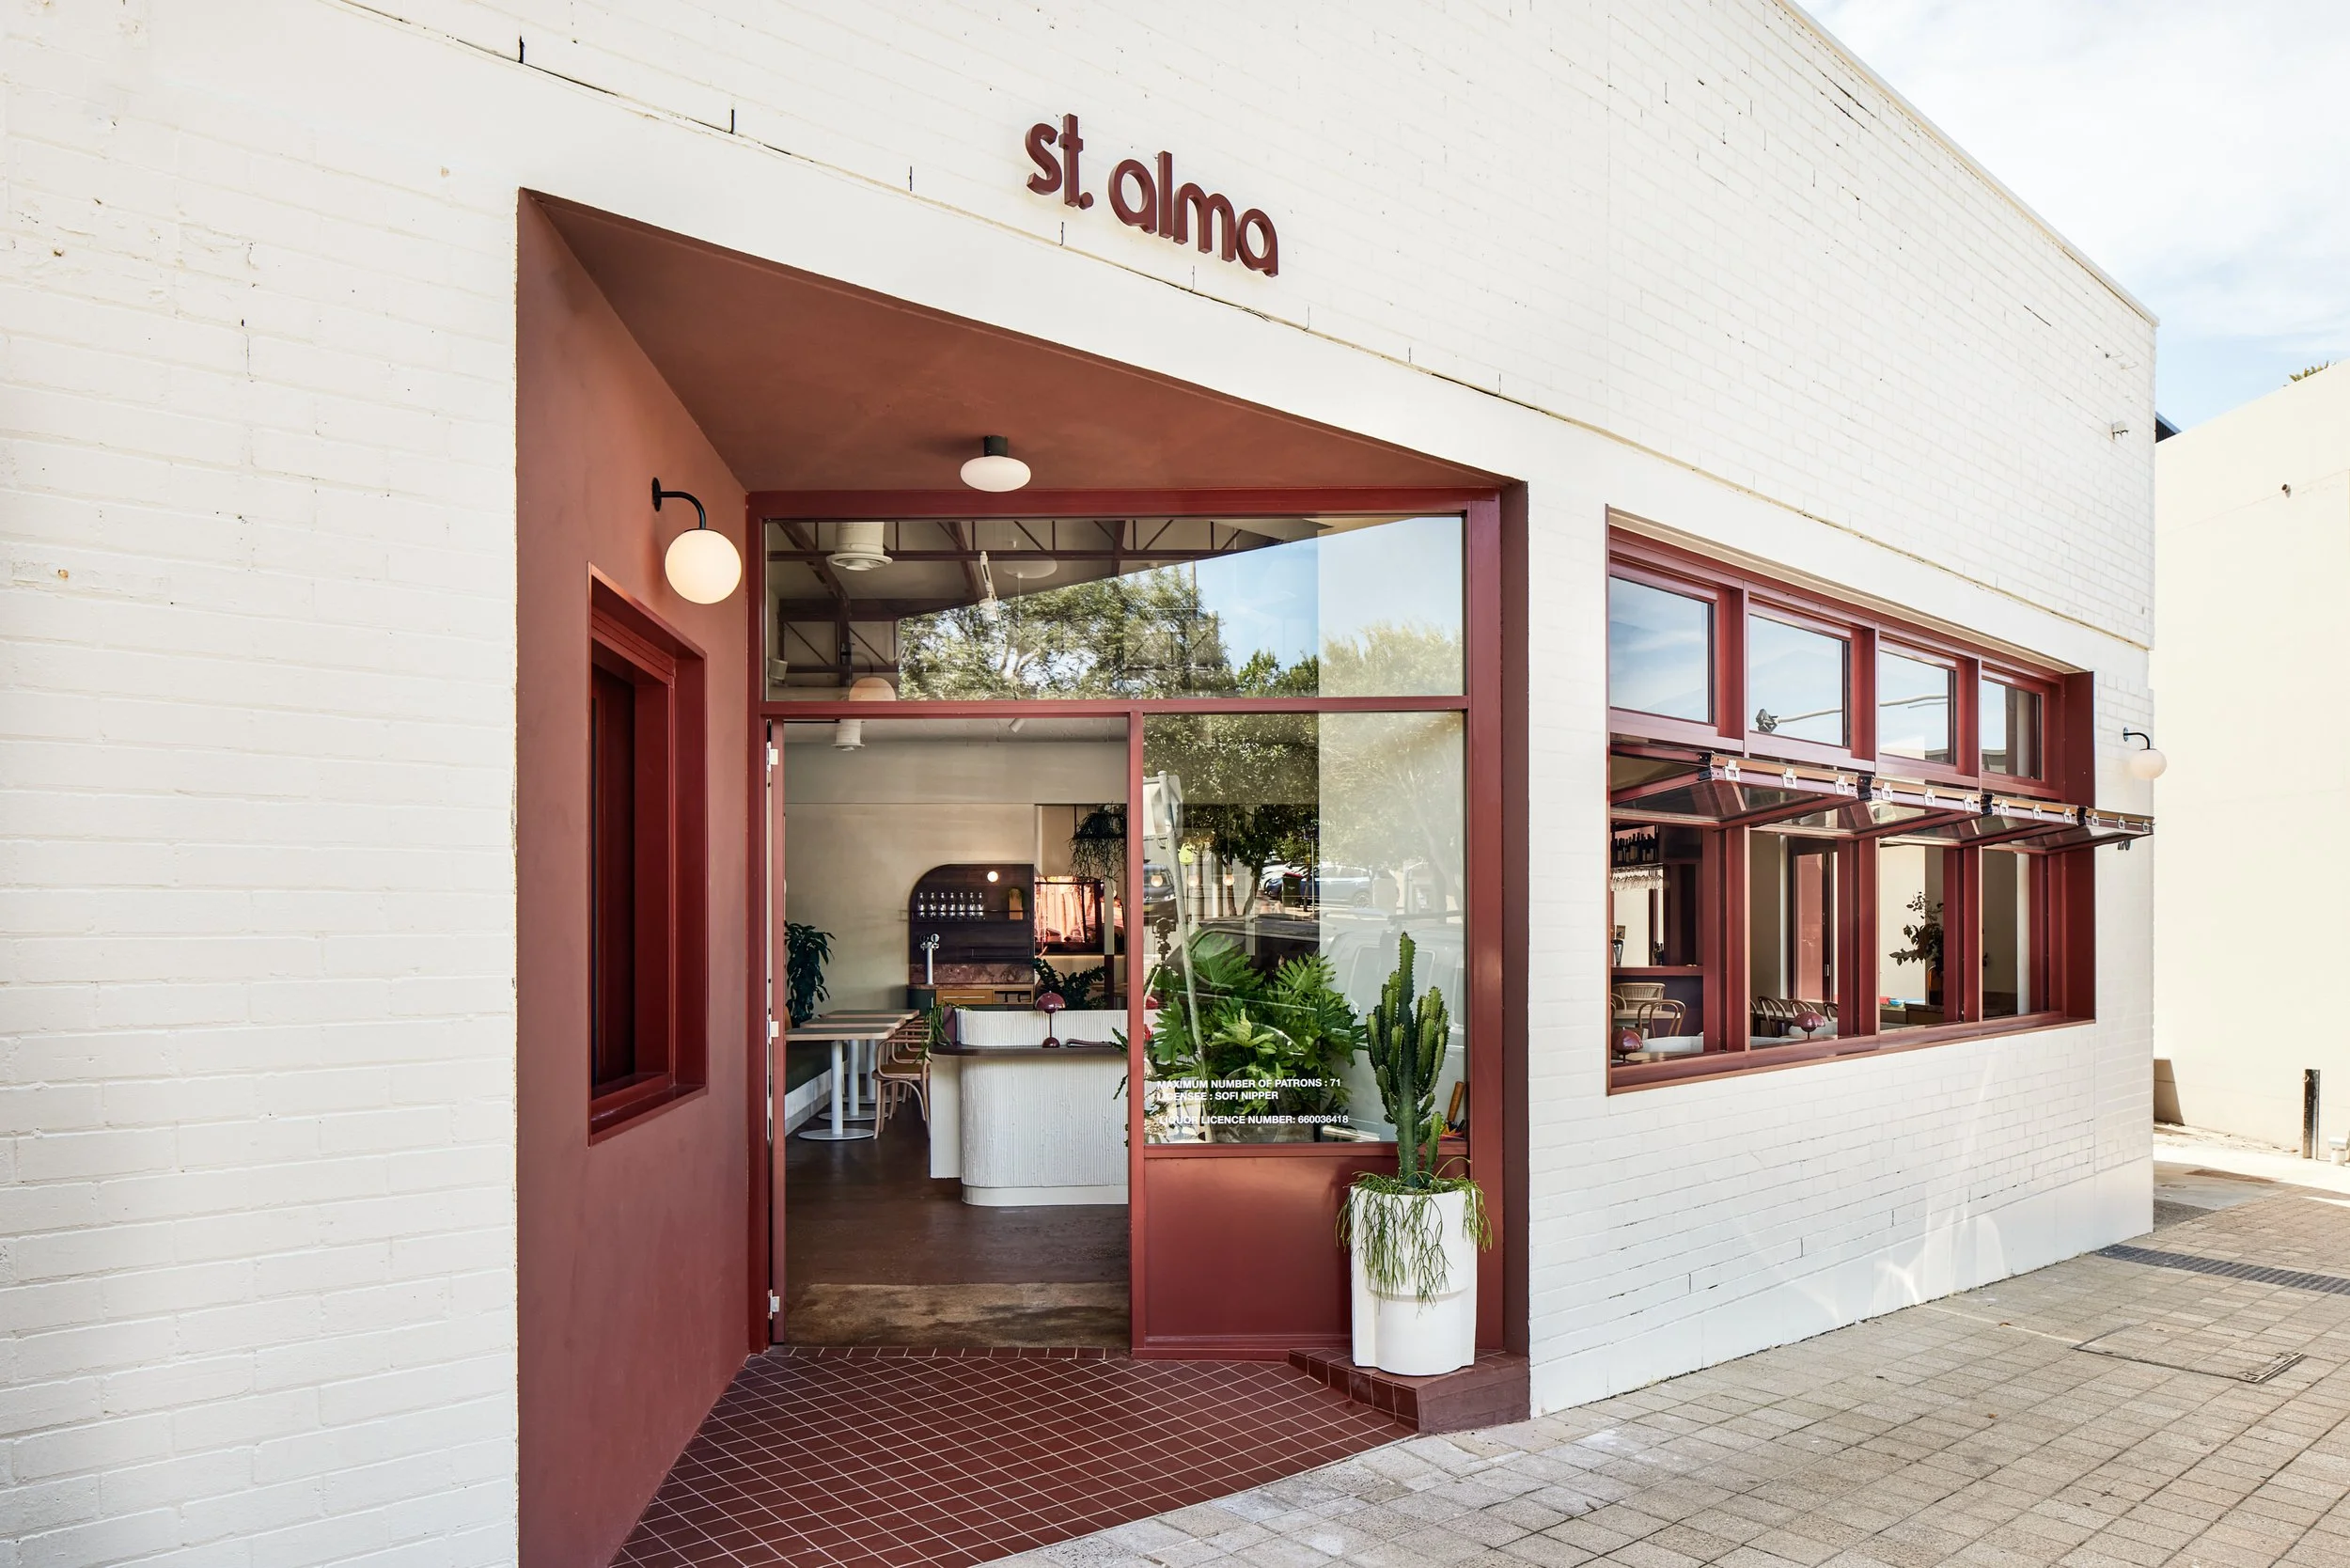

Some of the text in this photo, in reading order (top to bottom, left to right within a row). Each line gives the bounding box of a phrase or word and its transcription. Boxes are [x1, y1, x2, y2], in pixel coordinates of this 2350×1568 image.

[1025, 113, 1278, 277] st. alma
[1157, 1080, 1209, 1090] MAXIMUM
[1211, 1079, 1256, 1089] NUMBER
[1260, 1079, 1272, 1089] OF
[1275, 1078, 1322, 1088] PATRONS
[1329, 1078, 1340, 1088] 71
[1157, 1091, 1207, 1101] LICENSEE
[1214, 1091, 1239, 1101] SOFI
[1241, 1091, 1278, 1100] NIPPER
[1159, 1115, 1349, 1125] LIQUOR LICENCE NUMBER: 660036418
